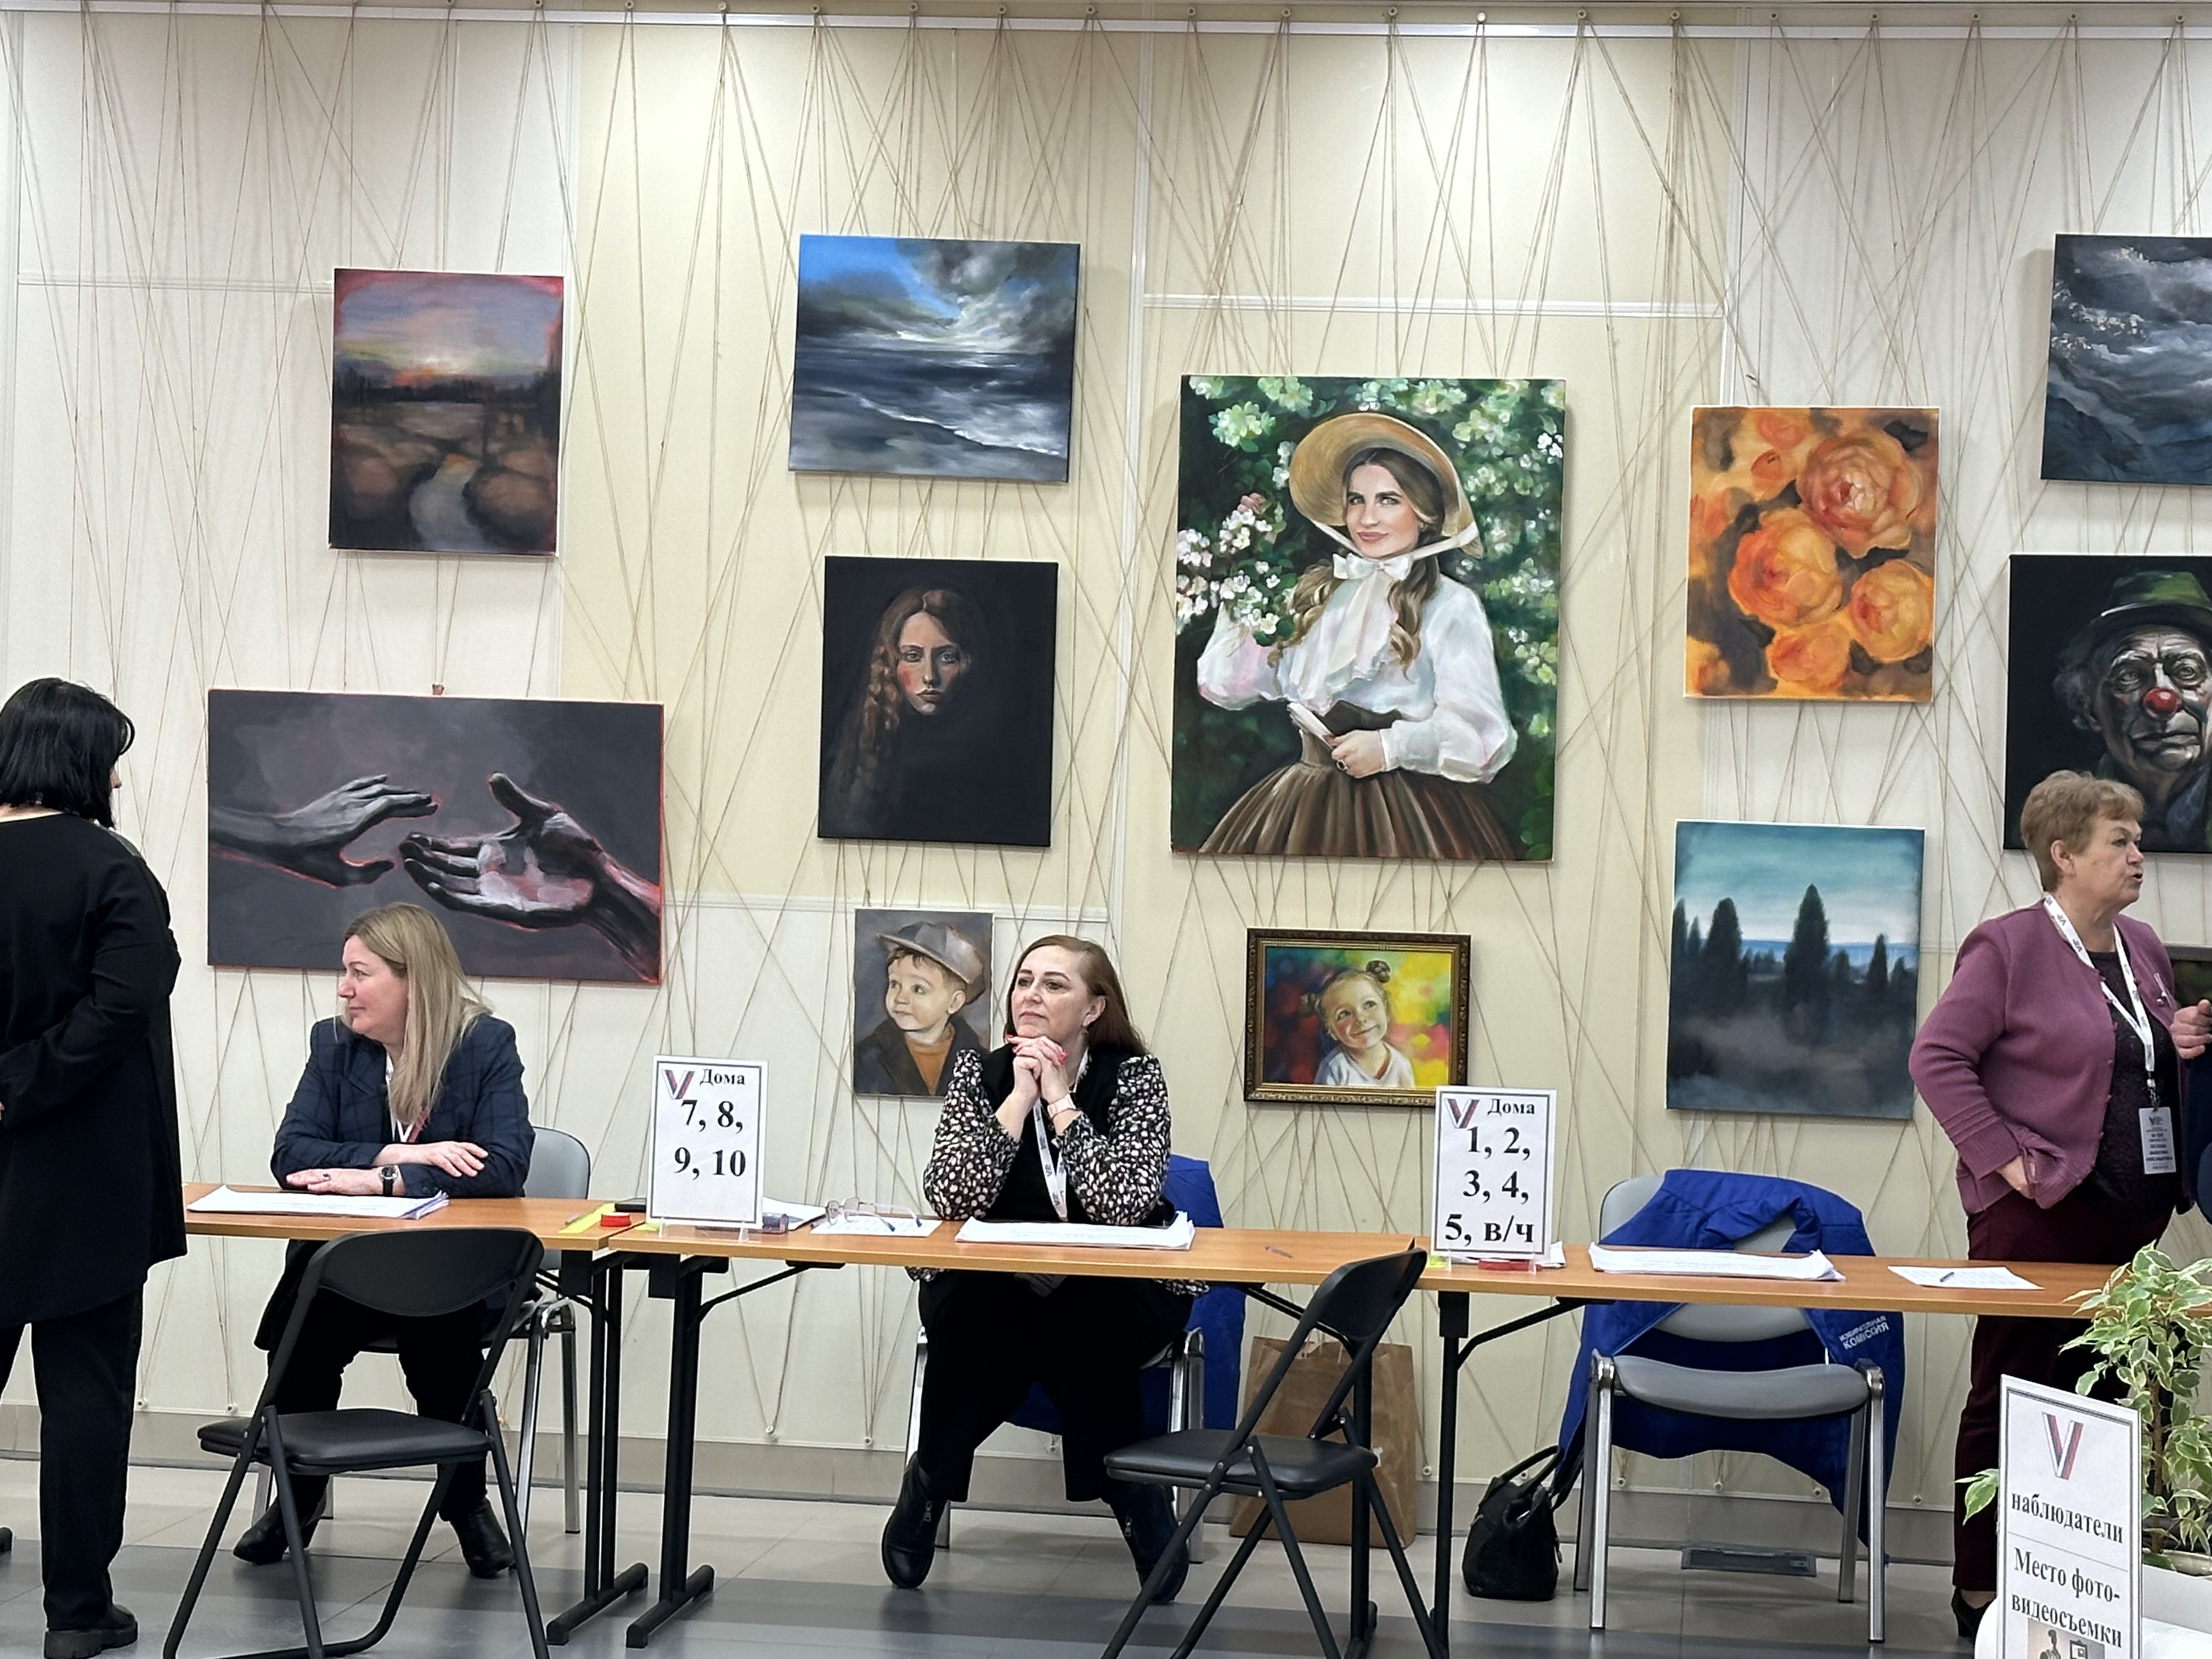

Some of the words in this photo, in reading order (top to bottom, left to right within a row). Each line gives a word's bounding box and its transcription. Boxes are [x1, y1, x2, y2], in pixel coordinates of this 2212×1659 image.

[699, 1069, 745, 1086] Дома
[681, 1099, 706, 1132] 7,
[717, 1101, 743, 1134] 8,
[1487, 1098, 1535, 1116] Дома
[1466, 1126, 1492, 1159] 1,
[1503, 1127, 1531, 1161] 2,
[674, 1147, 699, 1181] 9,
[712, 1149, 746, 1177] 10
[1463, 1170, 1491, 1203] 3,
[1502, 1170, 1529, 1205] 4,
[1445, 1214, 1472, 1246] 5,
[1484, 1215, 1534, 1243] в/ч
[2012, 1492, 2124, 1544] наблюдатели
[2014, 1547, 2067, 1586] Место
[2072, 1568, 2120, 1602] фото-
[2012, 1593, 2123, 1647] видеосъемки
